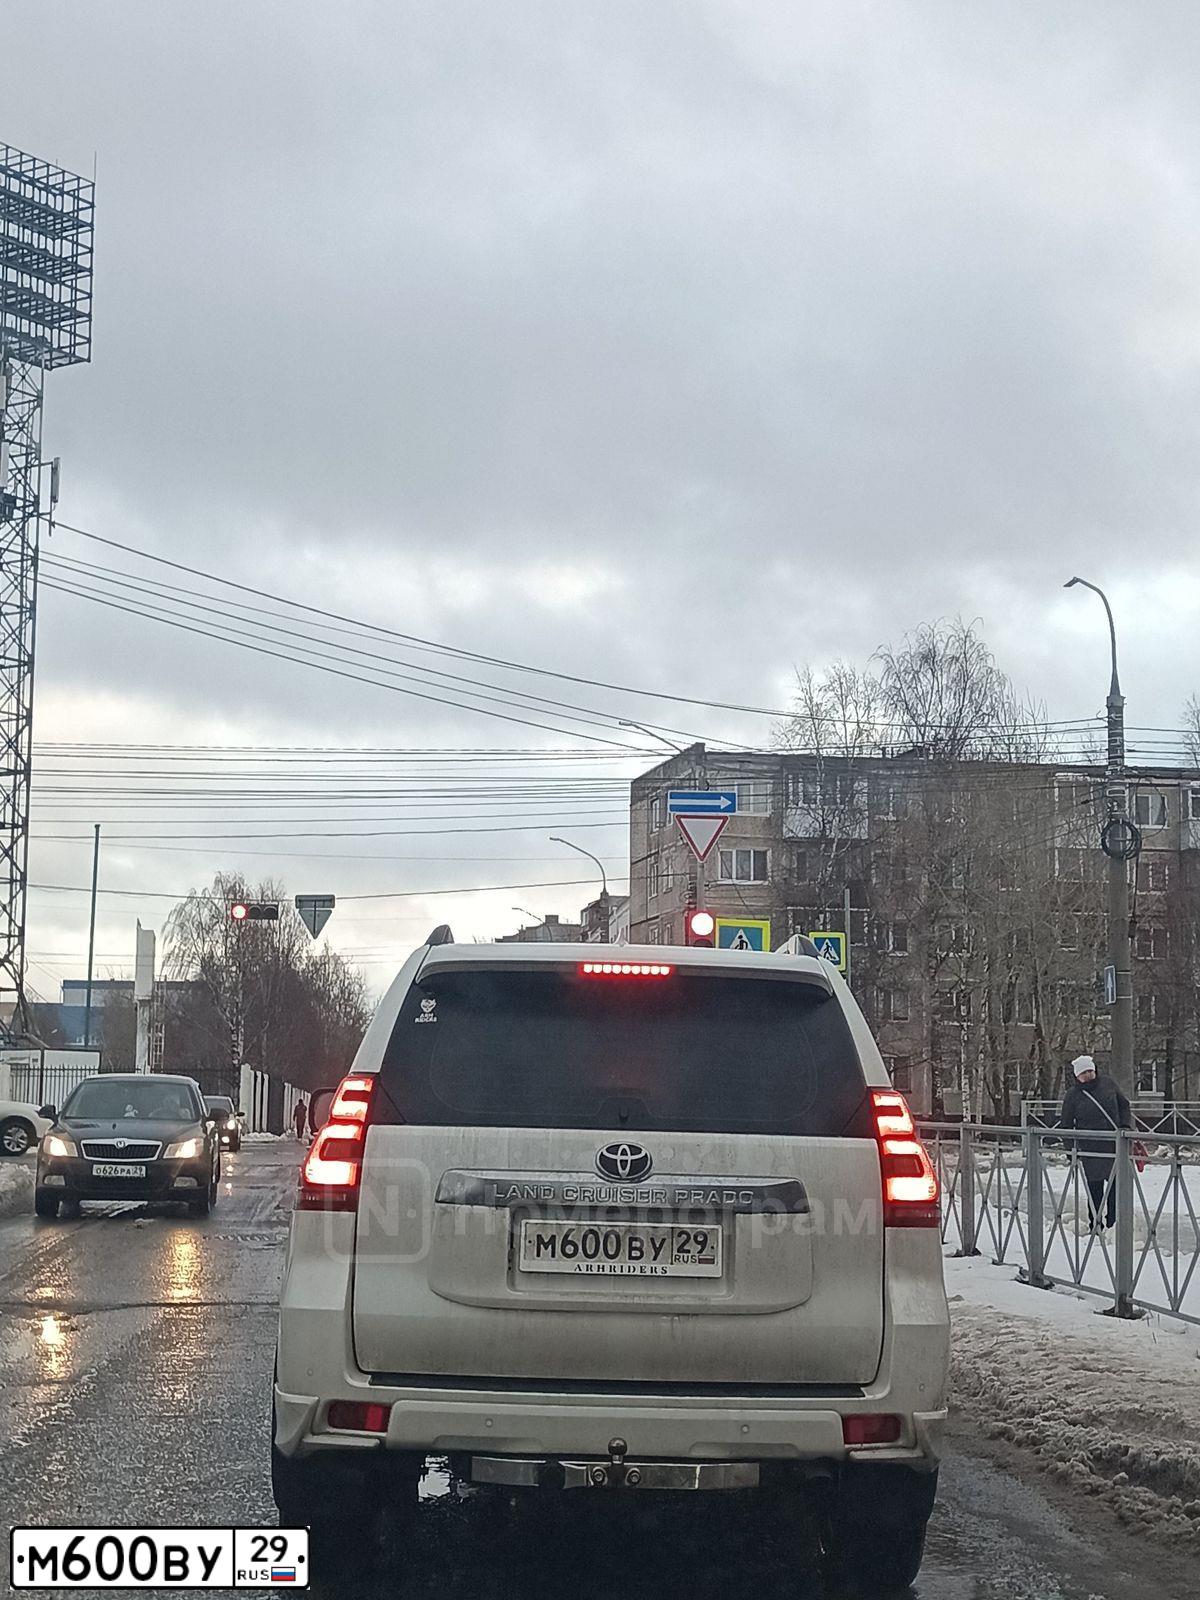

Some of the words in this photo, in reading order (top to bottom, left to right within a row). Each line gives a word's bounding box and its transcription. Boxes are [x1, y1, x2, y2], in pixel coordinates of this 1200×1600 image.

[493, 1184, 555, 1200] LAND
[563, 1186, 668, 1203] CRUISER
[675, 1189, 755, 1204] PRADO
[535, 1228, 667, 1261] М600ВУ
[676, 1230, 709, 1254] 29
[674, 1254, 698, 1264] RUS
[573, 1263, 668, 1275] ARHRIDERS
